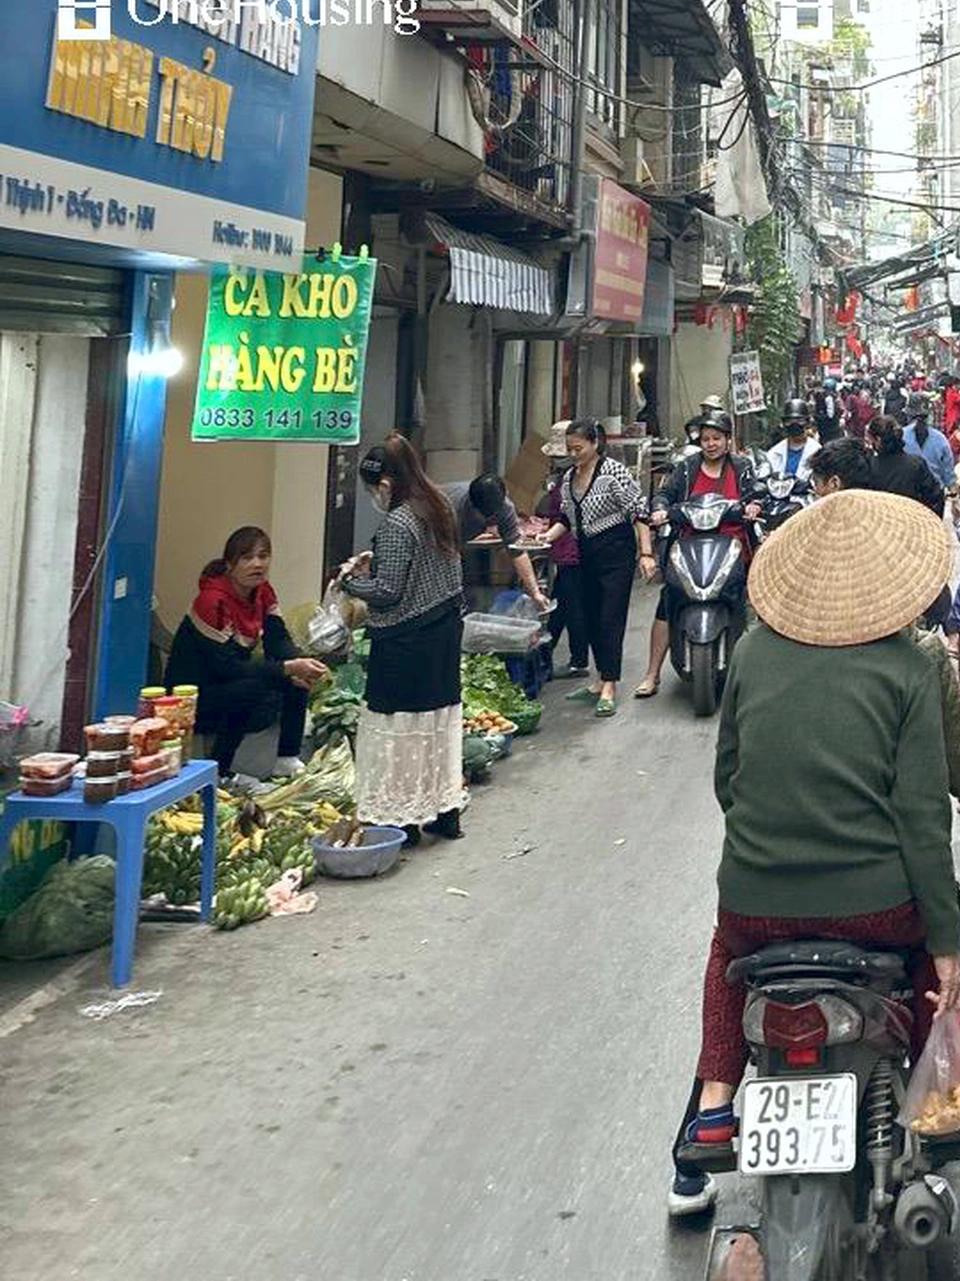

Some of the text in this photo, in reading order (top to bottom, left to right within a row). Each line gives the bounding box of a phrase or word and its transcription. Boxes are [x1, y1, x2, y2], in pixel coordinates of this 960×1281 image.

[279, 273, 358, 319] KHO
[206, 331, 306, 393] HÀNG
[201, 407, 352, 430] 0833 141 139
